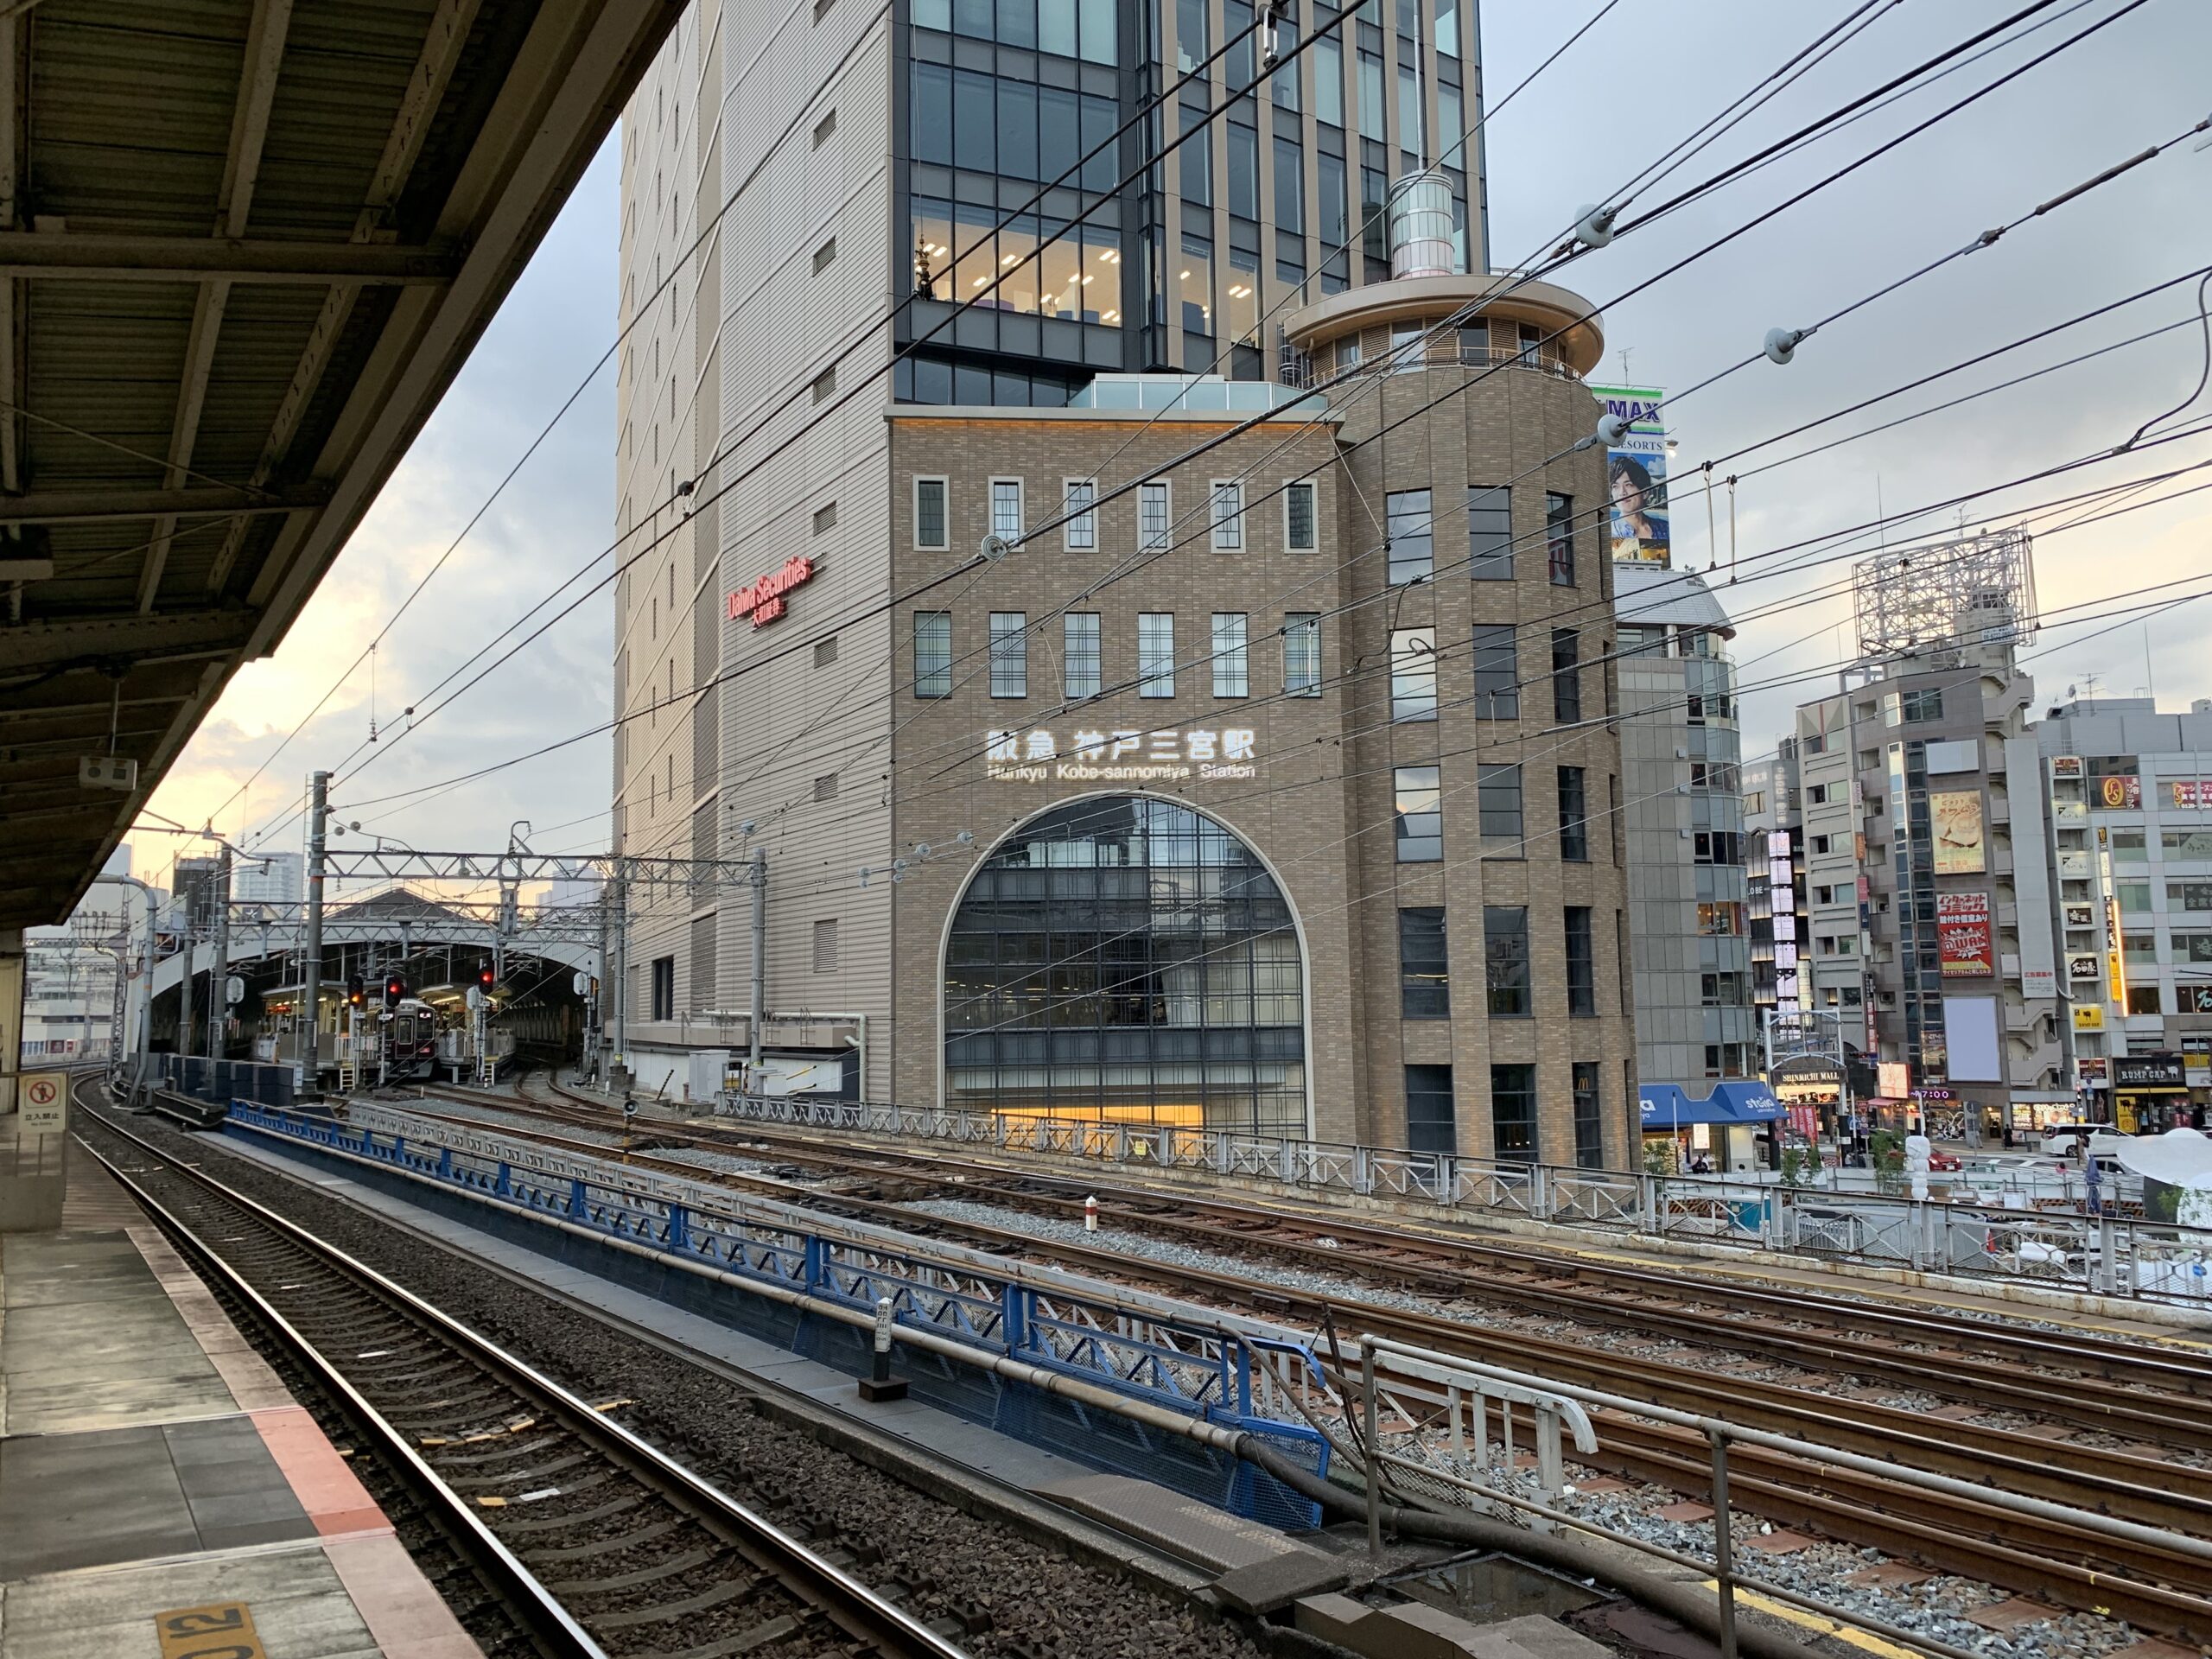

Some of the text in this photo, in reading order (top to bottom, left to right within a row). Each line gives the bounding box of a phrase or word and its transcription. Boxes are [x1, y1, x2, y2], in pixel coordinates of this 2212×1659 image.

[1616, 440, 1662, 450] ESORTS
[756, 556, 813, 605] Securities
[988, 729, 1255, 760] 阪急 神戸三宮駅
[988, 764, 1047, 784] Hankyu
[1200, 764, 1255, 779] Station
[1939, 893, 1986, 905] インターネット
[1940, 903, 1985, 912] コミック
[1820, 1071, 1840, 1080] MALL
[25, 1112, 60, 1121] 立入禁止
